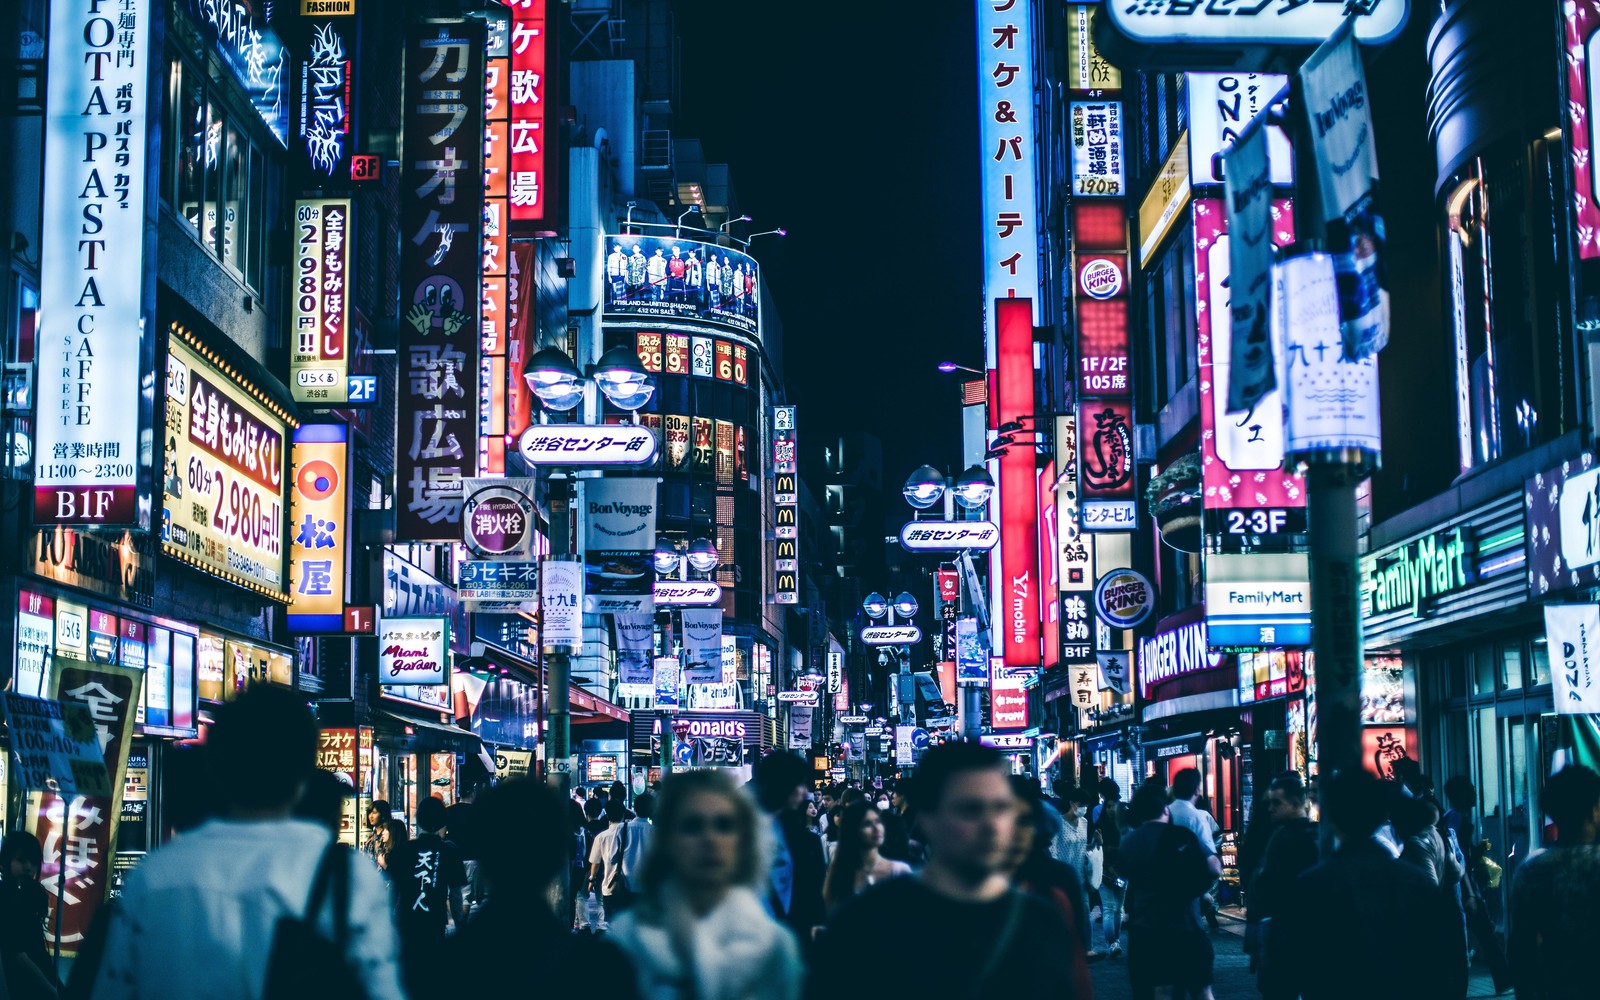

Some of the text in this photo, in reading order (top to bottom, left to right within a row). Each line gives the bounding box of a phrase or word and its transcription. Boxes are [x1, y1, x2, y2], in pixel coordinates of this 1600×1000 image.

[307, 1, 349, 13] FASHION
[1079, 12, 1087, 79] TORIKIZOKU
[115, 83, 134, 113] ポタ
[114, 121, 132, 167] パスタ
[355, 158, 377, 178] 3F
[114, 173, 130, 209] カフェ
[1080, 178, 1119, 194] 190円
[75, 132, 109, 306] PASTA
[298, 208, 320, 222] 60分
[323, 210, 345, 356] 全身もみほぐし
[408, 27, 469, 525] カラオケ 歌広場
[1087, 267, 1115, 281] BURGER
[1088, 274, 1116, 290] KING
[297, 225, 318, 352] 2,980円!!
[660, 308, 676, 316] SALE
[669, 302, 697, 311] SHADOWS
[638, 335, 661, 346] 飲み
[666, 336, 688, 347] 放題
[704, 340, 712, 375] やきとり
[1081, 357, 1127, 372] 1F/2F
[75, 314, 95, 426] CAFFE
[301, 373, 334, 383] りらくる
[720, 360, 732, 379] 6
[60, 336, 72, 426] STREET
[349, 380, 375, 399] 2F
[1083, 375, 1127, 389] 105席
[306, 389, 328, 398] 渋谷店
[666, 416, 688, 431] 30分
[190, 382, 281, 487] 全身もみほぐし
[667, 431, 688, 443] 飲み
[52, 442, 121, 459] 営業時間
[527, 436, 647, 453] 渋谷センター街
[188, 455, 212, 495] 60分
[55, 490, 114, 519] B1F
[213, 469, 280, 556] 2,980円!!
[589, 502, 652, 517] Bon Voyage
[475, 512, 522, 536] 消火栓
[1083, 507, 1135, 523] センタービル
[593, 522, 617, 537] Shibuya
[907, 529, 994, 541] 渋谷センター街
[296, 514, 337, 596] 松屋
[479, 563, 537, 582] セキネ
[1367, 526, 1467, 618] FamilyMart
[460, 590, 475, 598] 買取
[472, 581, 530, 590] 03-3464-2061
[1104, 581, 1145, 600] BURGER
[29, 594, 42, 614] B1F
[1013, 570, 1029, 644] Y!mobile
[1105, 590, 1147, 614] KING
[1229, 591, 1303, 606] FamilyMart
[350, 610, 371, 631] 1F
[684, 621, 721, 631] Bon Voyage
[1064, 593, 1089, 640] 米助
[61, 618, 81, 641] りらくる
[383, 631, 441, 641] パスタとピザ
[617, 622, 653, 632] Bon Voyage
[864, 630, 917, 639] 渋谷センター街
[1260, 627, 1275, 643] 酒
[381, 644, 429, 658] Miami
[1065, 646, 1091, 658] B1F
[1145, 631, 1178, 684] BURGER
[1179, 622, 1221, 674] KIN
[830, 670, 840, 692] 牛タン
[1105, 656, 1123, 692] 寿司
[1077, 671, 1093, 704] 寿司
[320, 732, 355, 748] ラオケ
[412, 851, 433, 912] 天下人
